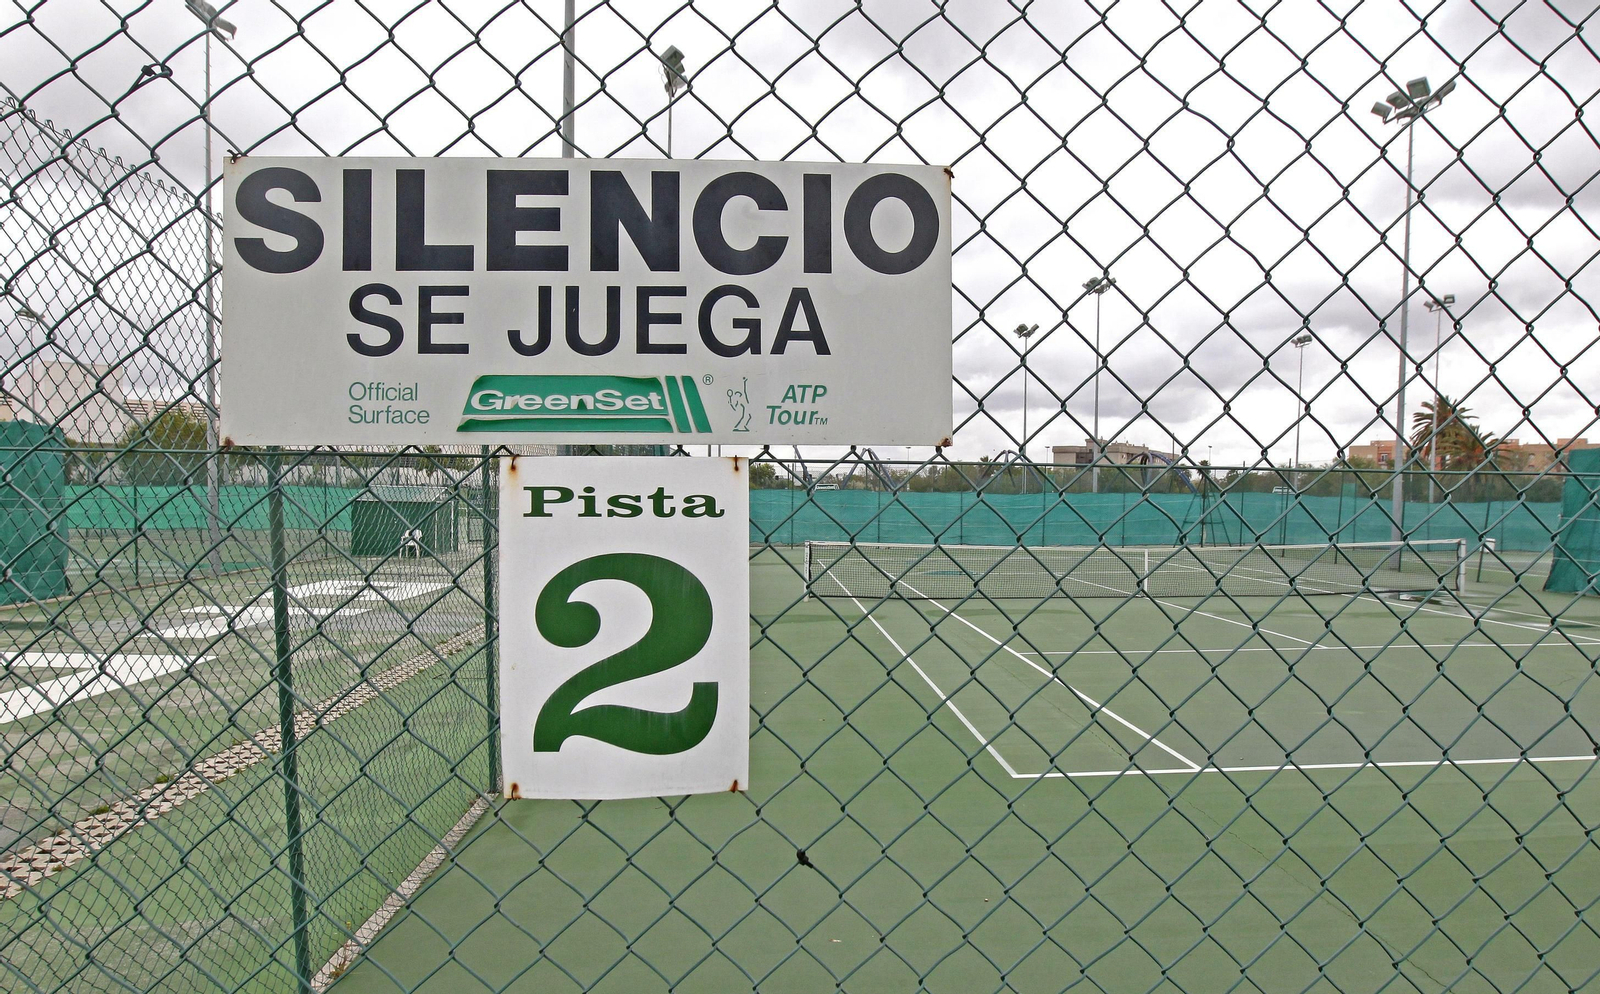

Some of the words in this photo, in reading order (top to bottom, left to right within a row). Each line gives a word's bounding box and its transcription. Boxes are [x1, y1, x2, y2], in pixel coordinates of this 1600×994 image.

[234, 166, 940, 276] SILENCIO
[346, 283, 470, 357] SE
[507, 284, 831, 358] JUEGA
[348, 381, 418, 401] Official
[470, 389, 665, 411] GreenSet
[780, 384, 828, 404] ATP
[348, 404, 430, 424] Surface
[522, 486, 725, 518] Pista
[533, 552, 719, 755] 2
